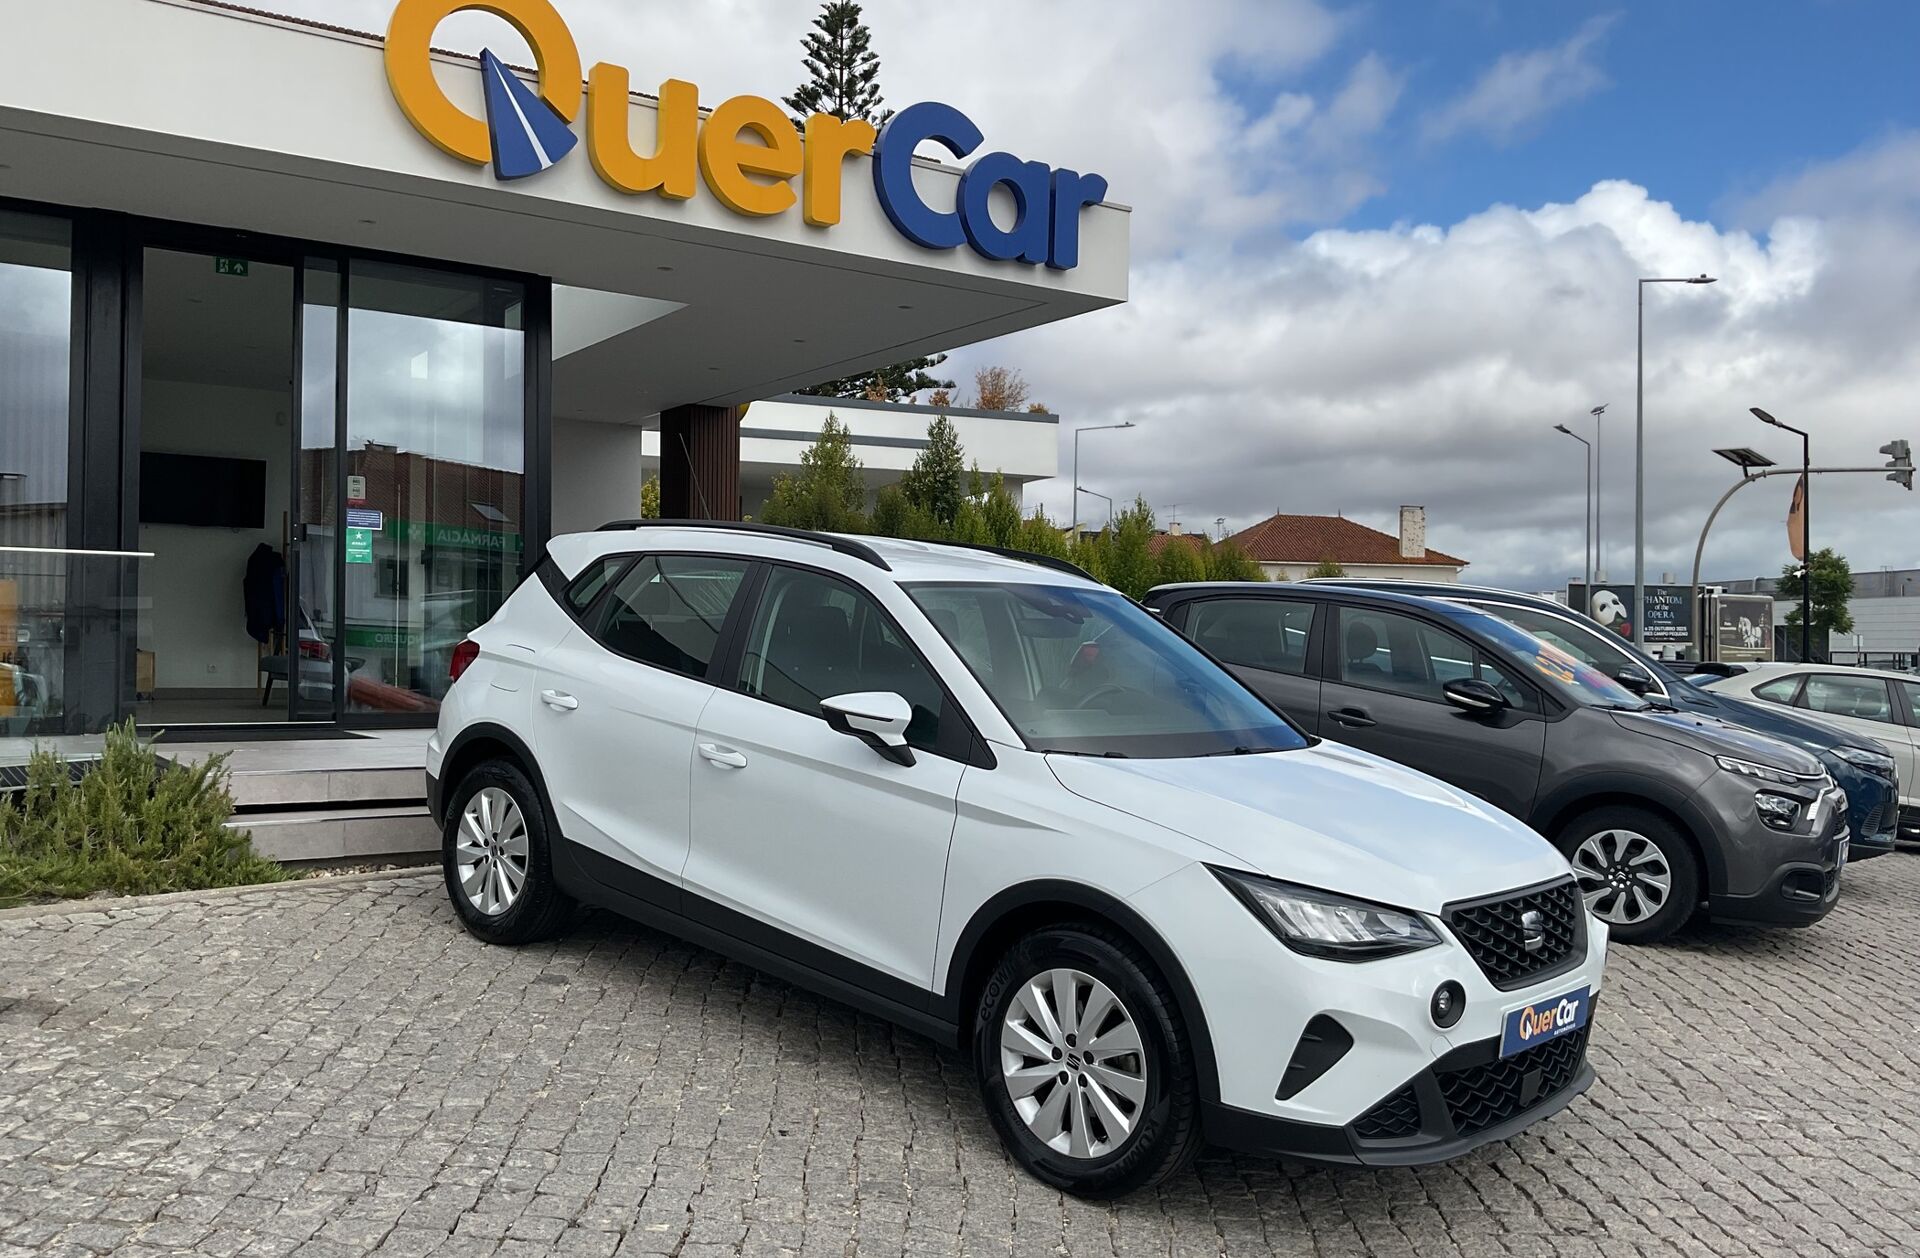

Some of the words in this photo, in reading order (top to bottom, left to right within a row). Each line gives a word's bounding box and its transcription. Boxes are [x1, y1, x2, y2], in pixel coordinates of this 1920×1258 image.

[384, 0, 1108, 270] QuerCar
[1647, 610, 1675, 619] OPERA
[1519, 998, 1579, 1041] QuerCar
